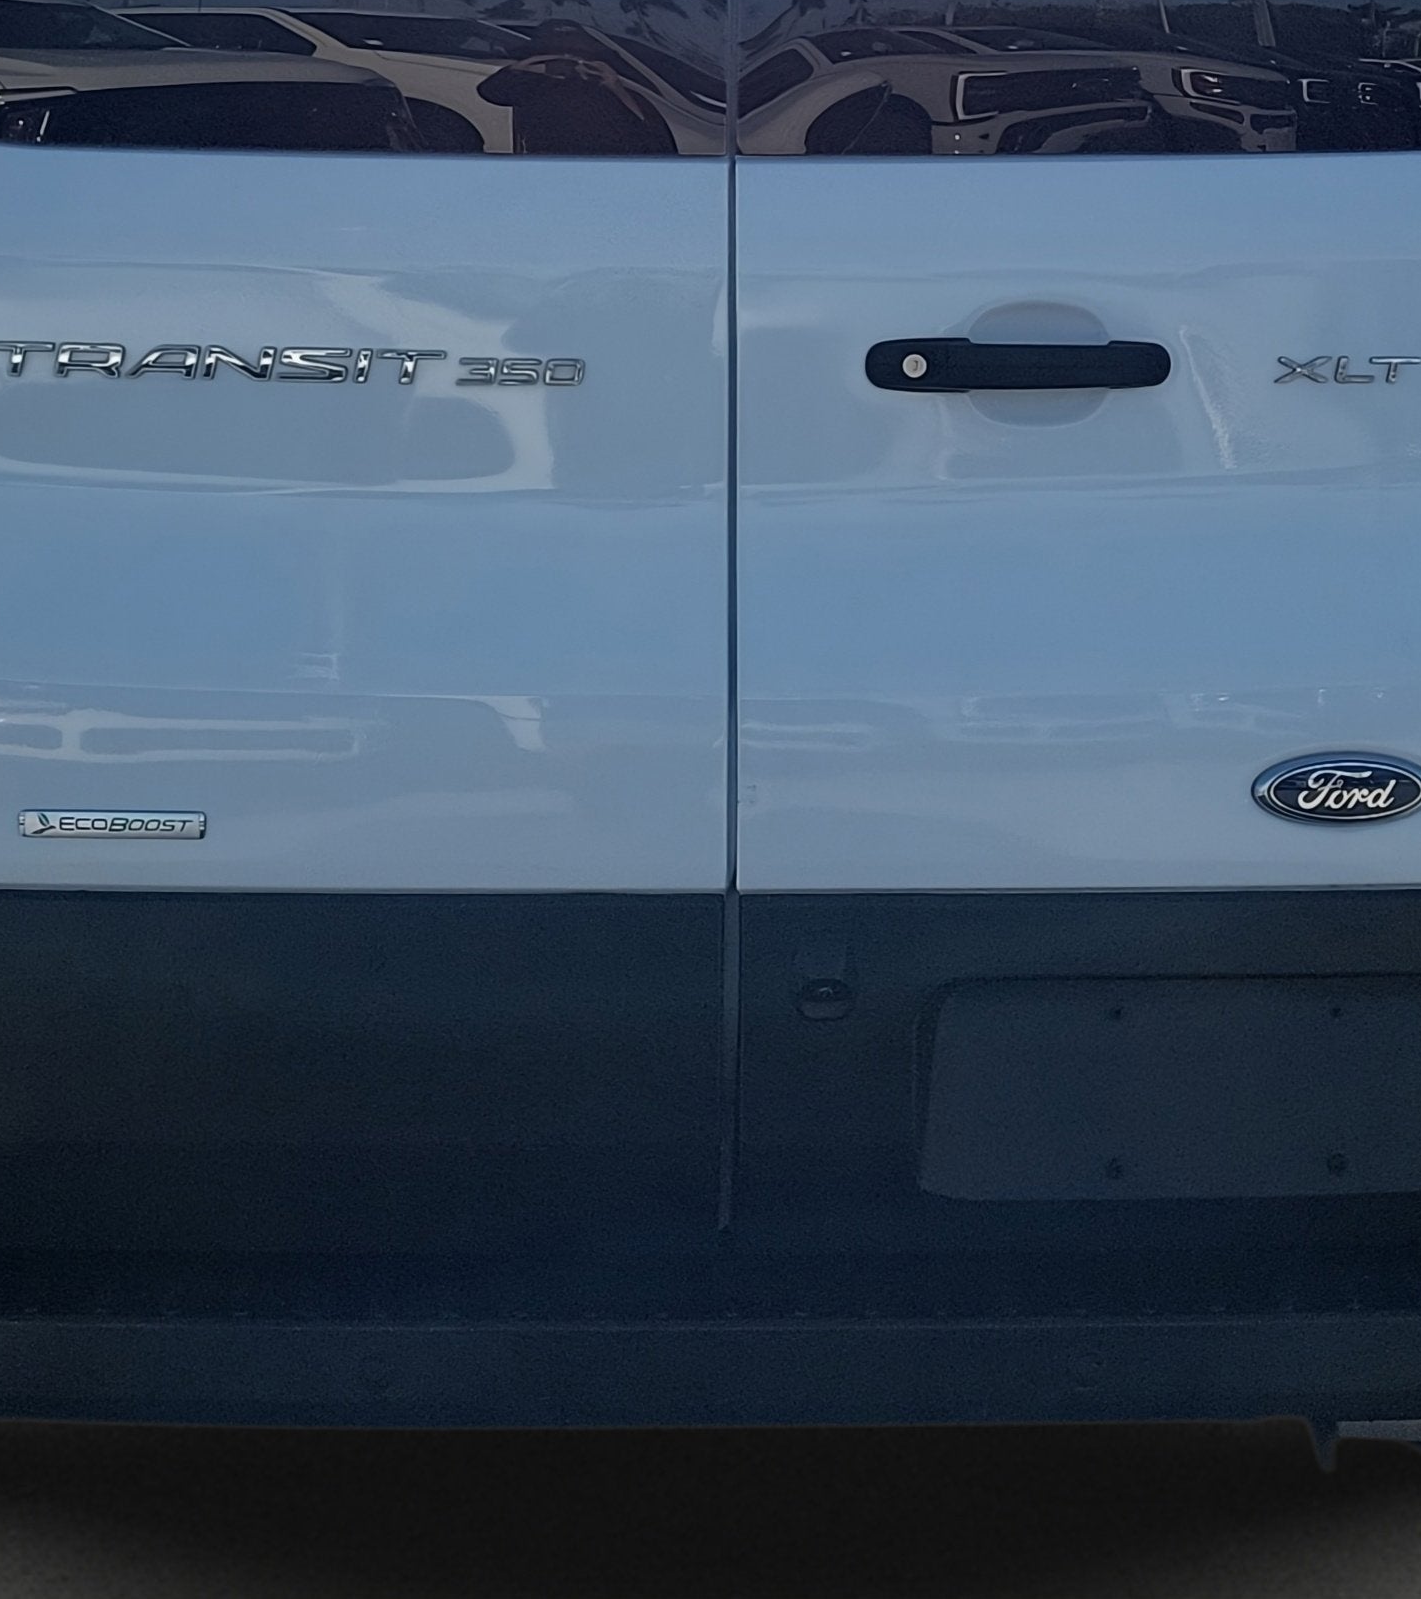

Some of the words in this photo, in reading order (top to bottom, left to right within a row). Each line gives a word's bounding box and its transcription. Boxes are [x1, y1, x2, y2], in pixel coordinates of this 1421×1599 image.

[455, 357, 586, 386] 350
[1274, 355, 1421, 384] XLT
[1298, 769, 1397, 809] Ford
